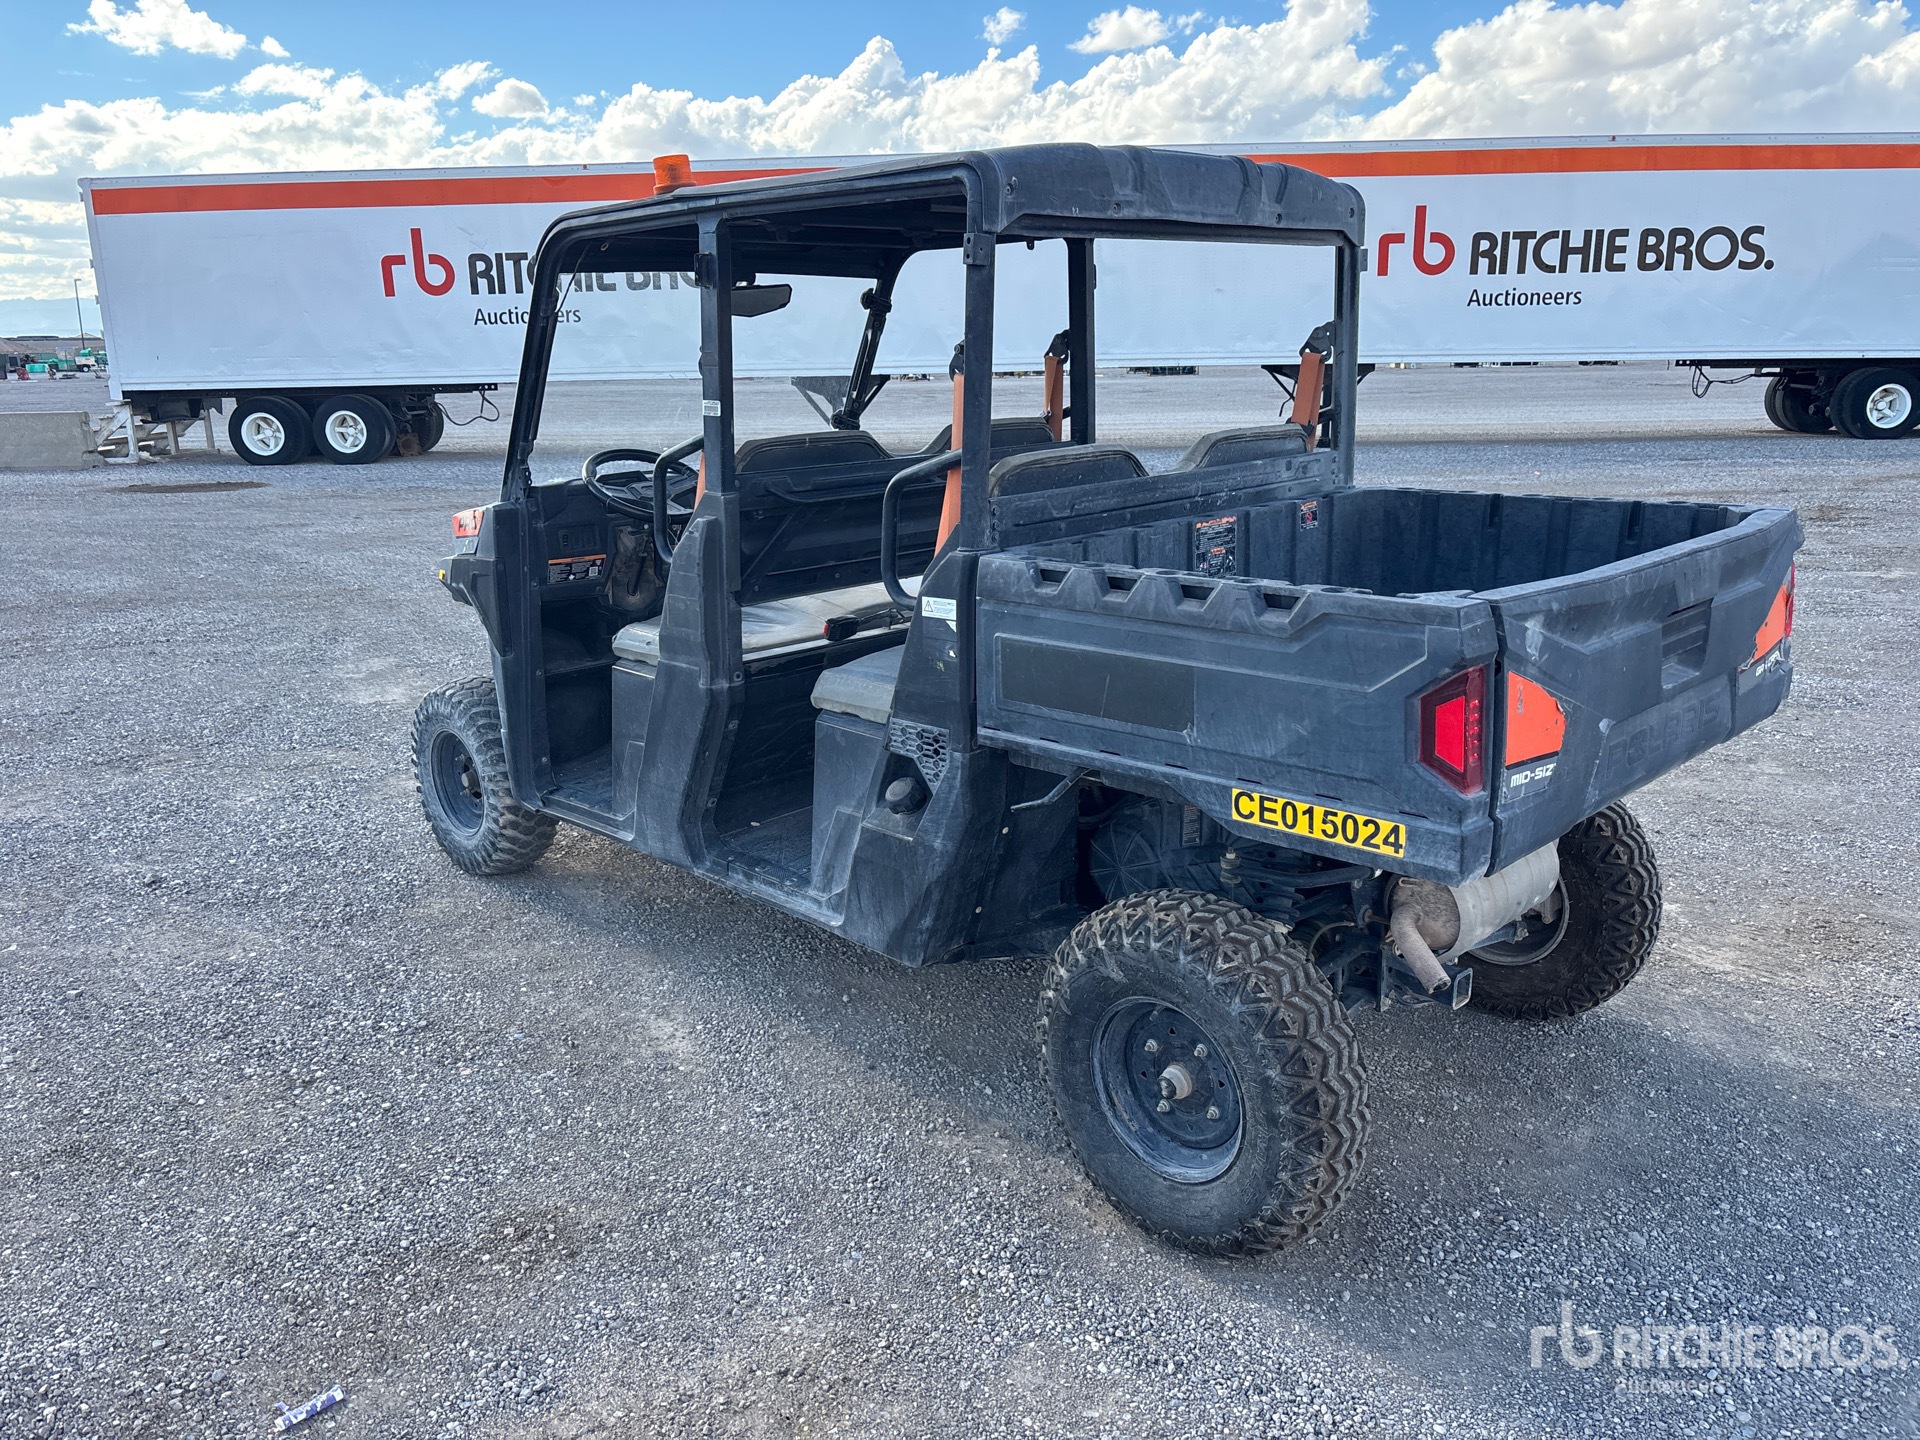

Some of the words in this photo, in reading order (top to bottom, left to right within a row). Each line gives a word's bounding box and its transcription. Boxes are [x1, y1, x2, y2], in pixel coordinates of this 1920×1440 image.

[380, 227, 456, 297] rb
[1377, 205, 1455, 276] rb
[1469, 228, 1630, 275] RITCHIE
[1637, 225, 1775, 271] BROS.
[474, 307, 582, 326] Auctioers
[1467, 287, 1582, 307] Auctioneers
[1606, 690, 1721, 780] POLARIS
[1510, 762, 1557, 788] MID-SIZ
[1233, 790, 1404, 855] CE015024
